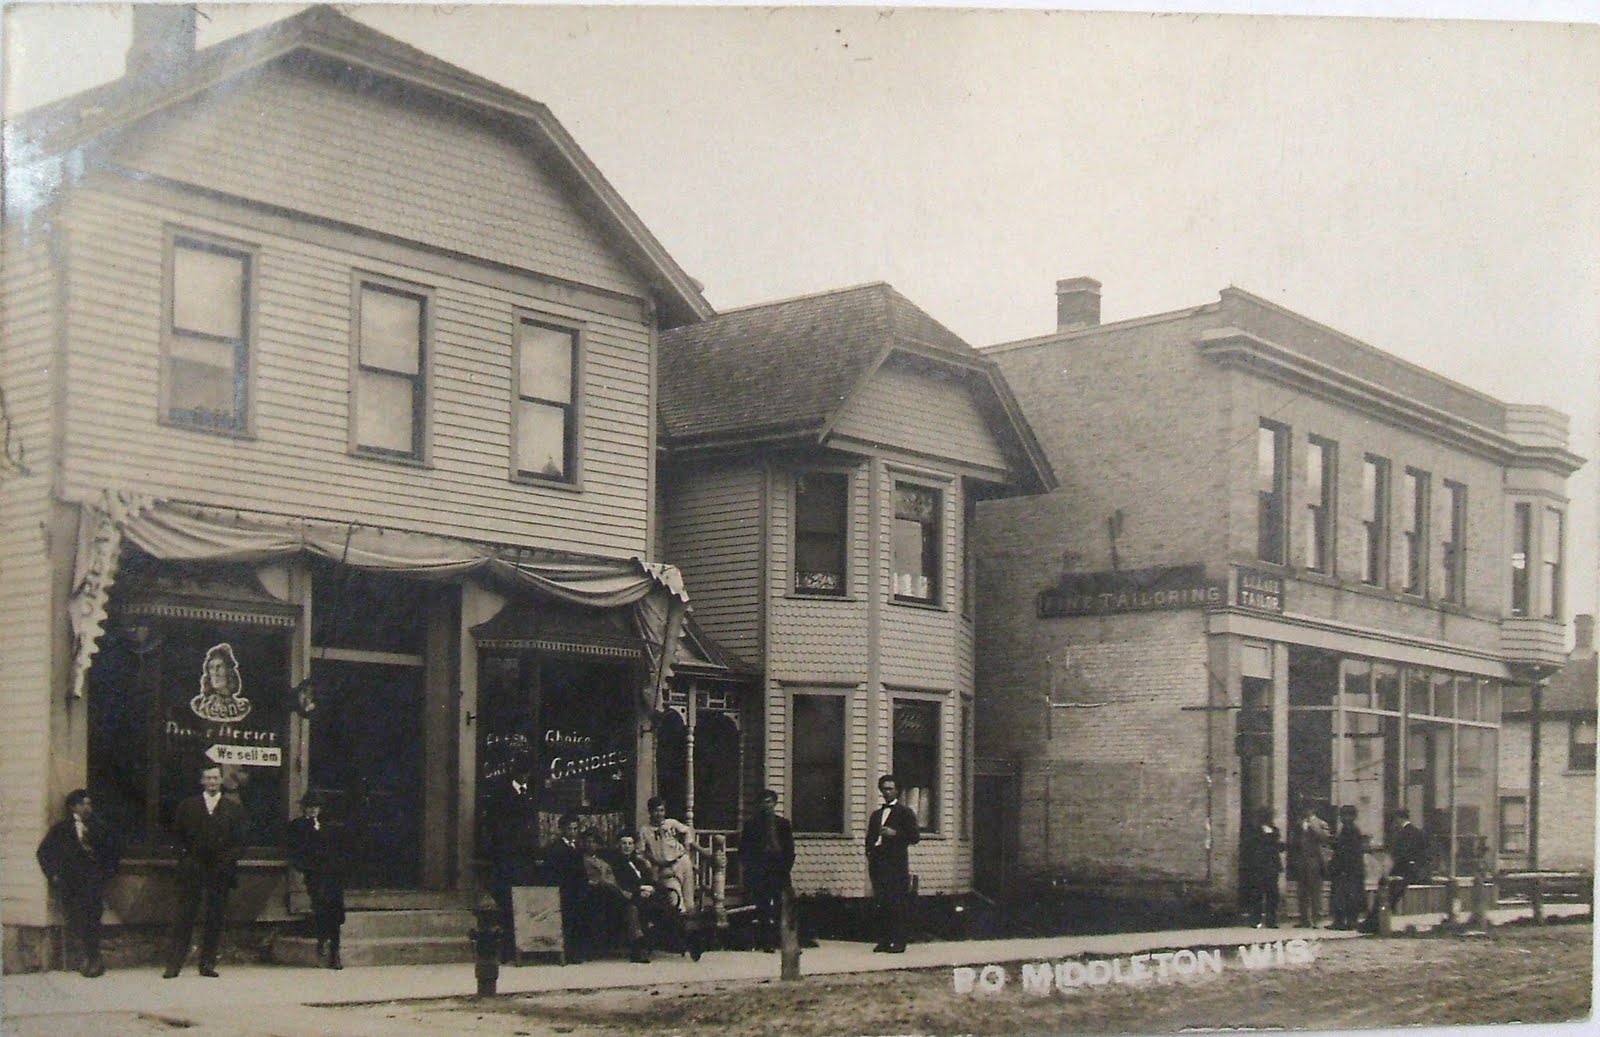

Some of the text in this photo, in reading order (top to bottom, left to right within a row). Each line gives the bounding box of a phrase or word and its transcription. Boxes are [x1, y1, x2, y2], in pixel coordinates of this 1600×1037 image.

[1098, 586, 1220, 610] TAILORING
[1241, 591, 1280, 611] TAILOR
[217, 748, 233, 760] We
[237, 749, 258, 761] sell
